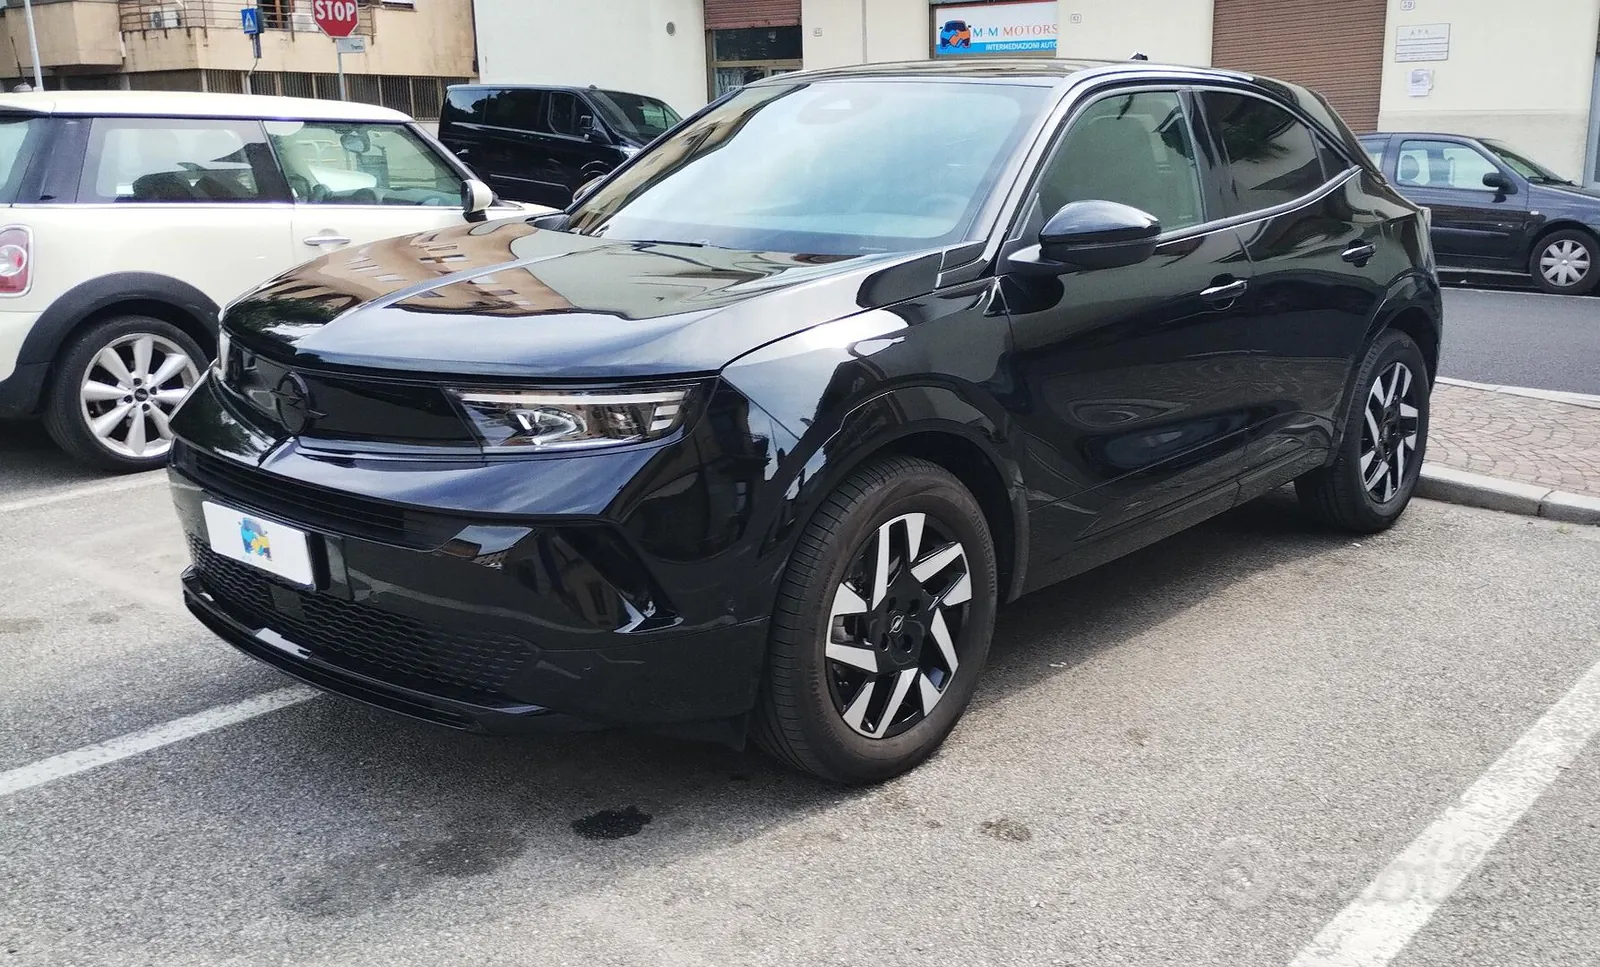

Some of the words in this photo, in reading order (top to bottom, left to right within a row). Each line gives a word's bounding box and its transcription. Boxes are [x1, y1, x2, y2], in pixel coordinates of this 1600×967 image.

[315, 0, 355, 21] STOP
[1003, 24, 1058, 36] MOTORS
[985, 42, 1040, 51] INTERMEDIAZIONI
